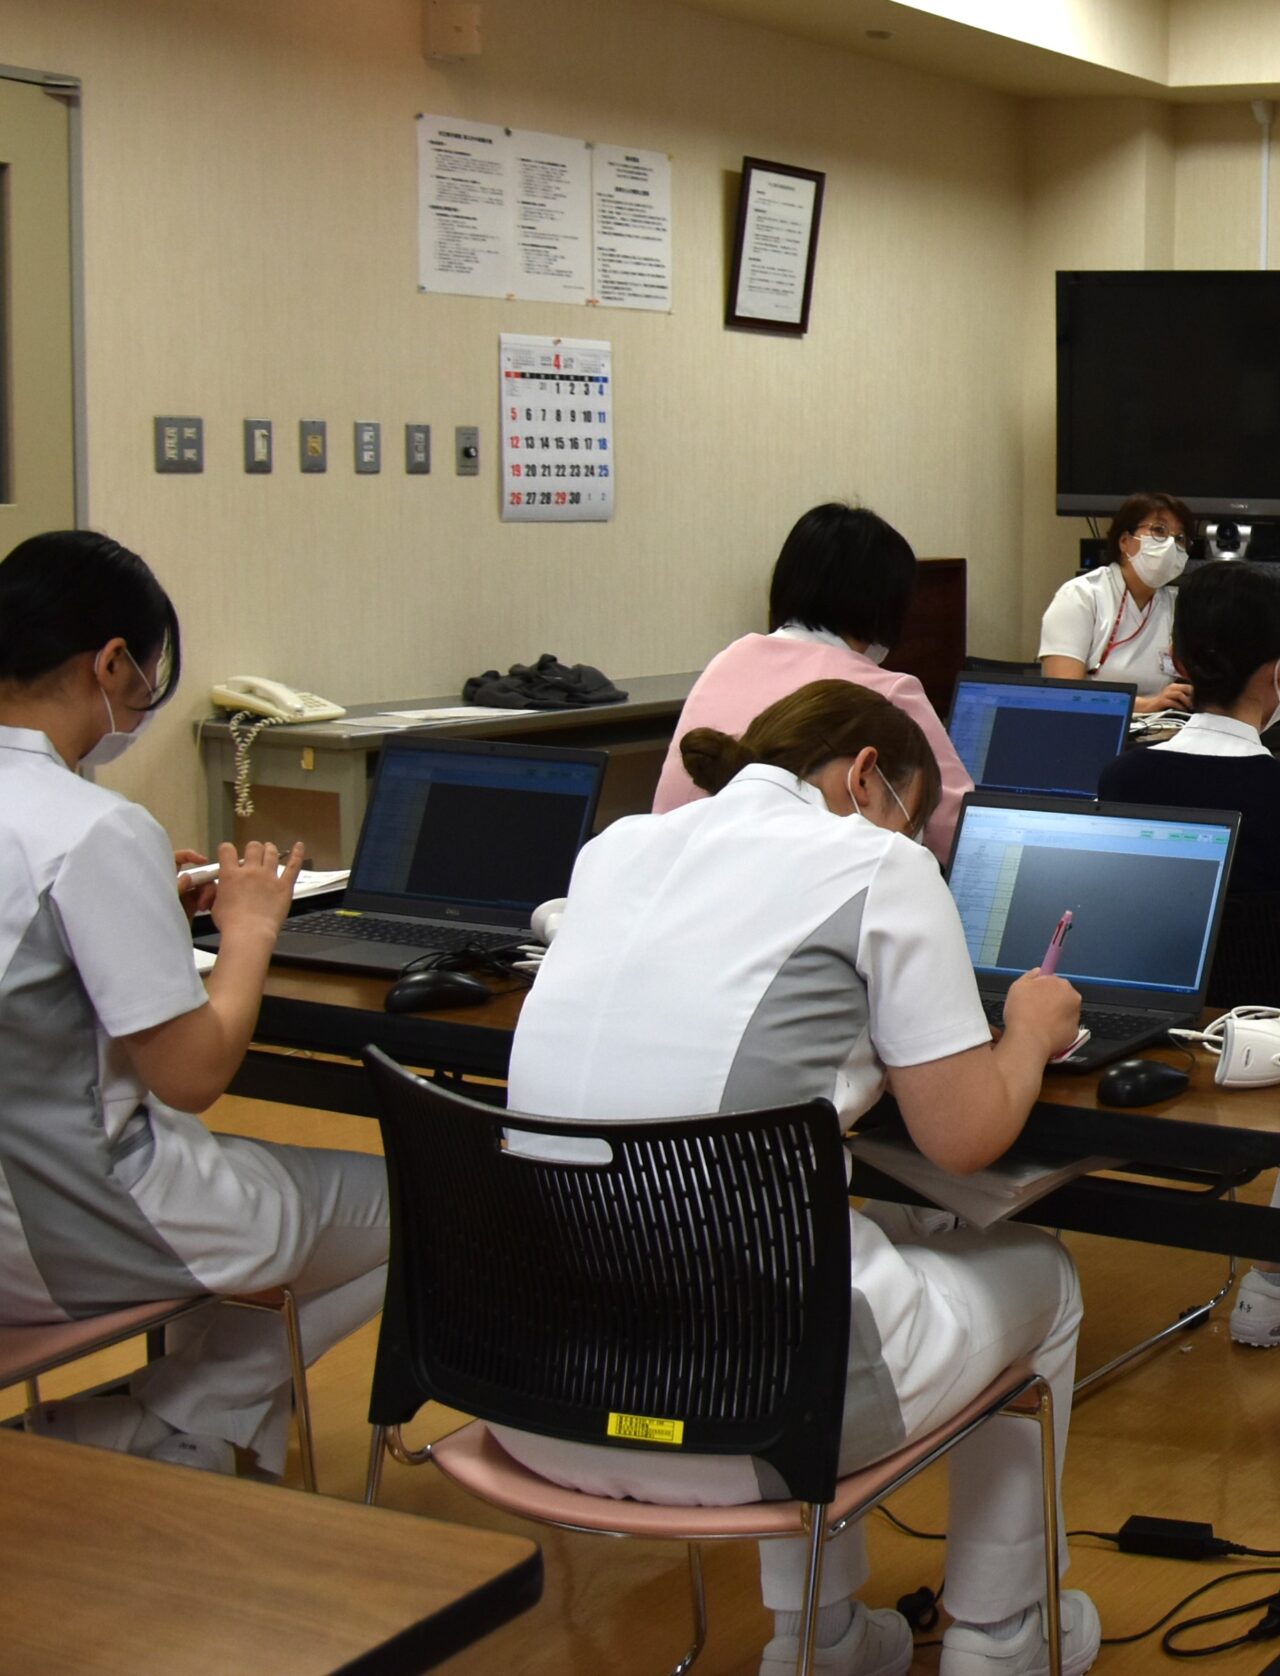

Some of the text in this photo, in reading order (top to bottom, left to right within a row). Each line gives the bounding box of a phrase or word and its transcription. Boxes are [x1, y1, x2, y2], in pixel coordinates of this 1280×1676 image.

[553, 353, 561, 370] 4
[555, 382, 561, 394] 1
[569, 382, 576, 395] 2
[583, 383, 590, 396] 3
[597, 383, 604, 396] 4
[510, 407, 606, 423] 5 6 7 8 9 10 11
[510, 436, 608, 450] 12 13 14 15 16 17 18
[511, 464, 609, 477] 19 20 21 22 23 24 25
[510, 492, 522, 505] 26
[526, 492, 537, 505] 27
[540, 492, 551, 505] 28
[554, 492, 566, 504] 29
[569, 492, 580, 504] 30
